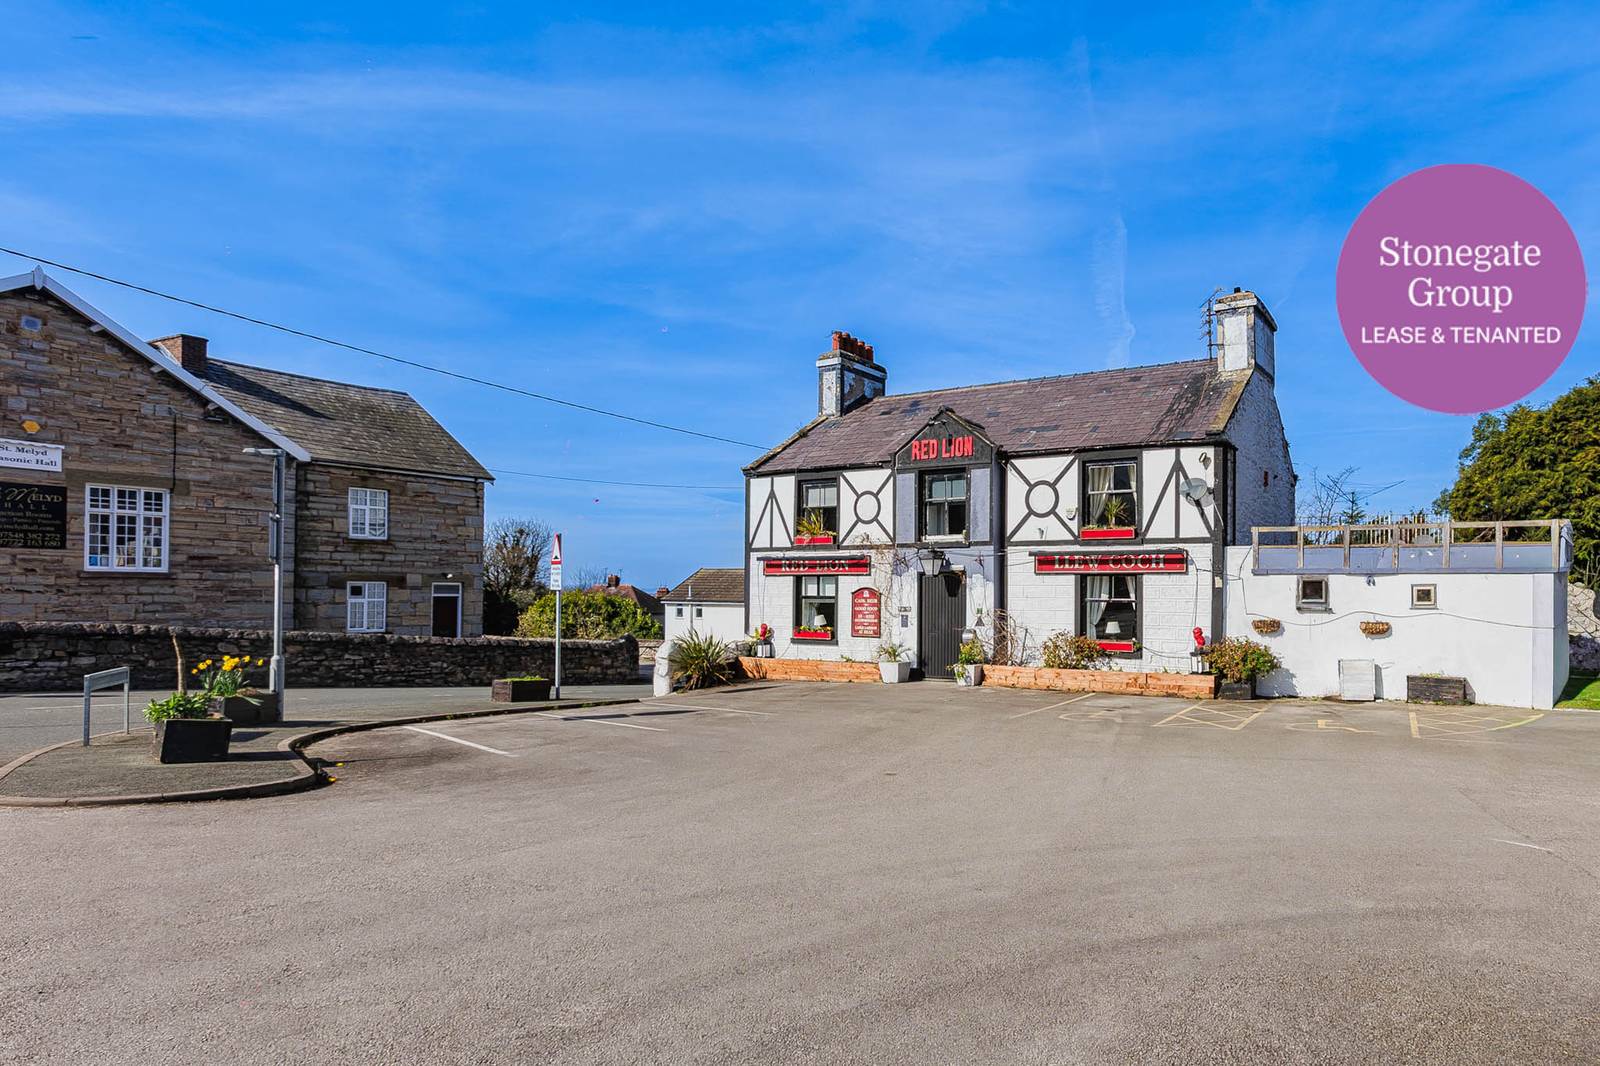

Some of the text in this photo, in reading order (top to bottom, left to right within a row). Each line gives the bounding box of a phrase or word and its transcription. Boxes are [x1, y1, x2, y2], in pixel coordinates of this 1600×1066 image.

[16, 446, 48, 456] Melyd
[911, 435, 974, 460] RED LION
[35, 459, 57, 467] Hall
[4, 502, 48, 510] HALL
[781, 559, 848, 571] RED LION
[1053, 554, 1165, 569] LLEW COCH
